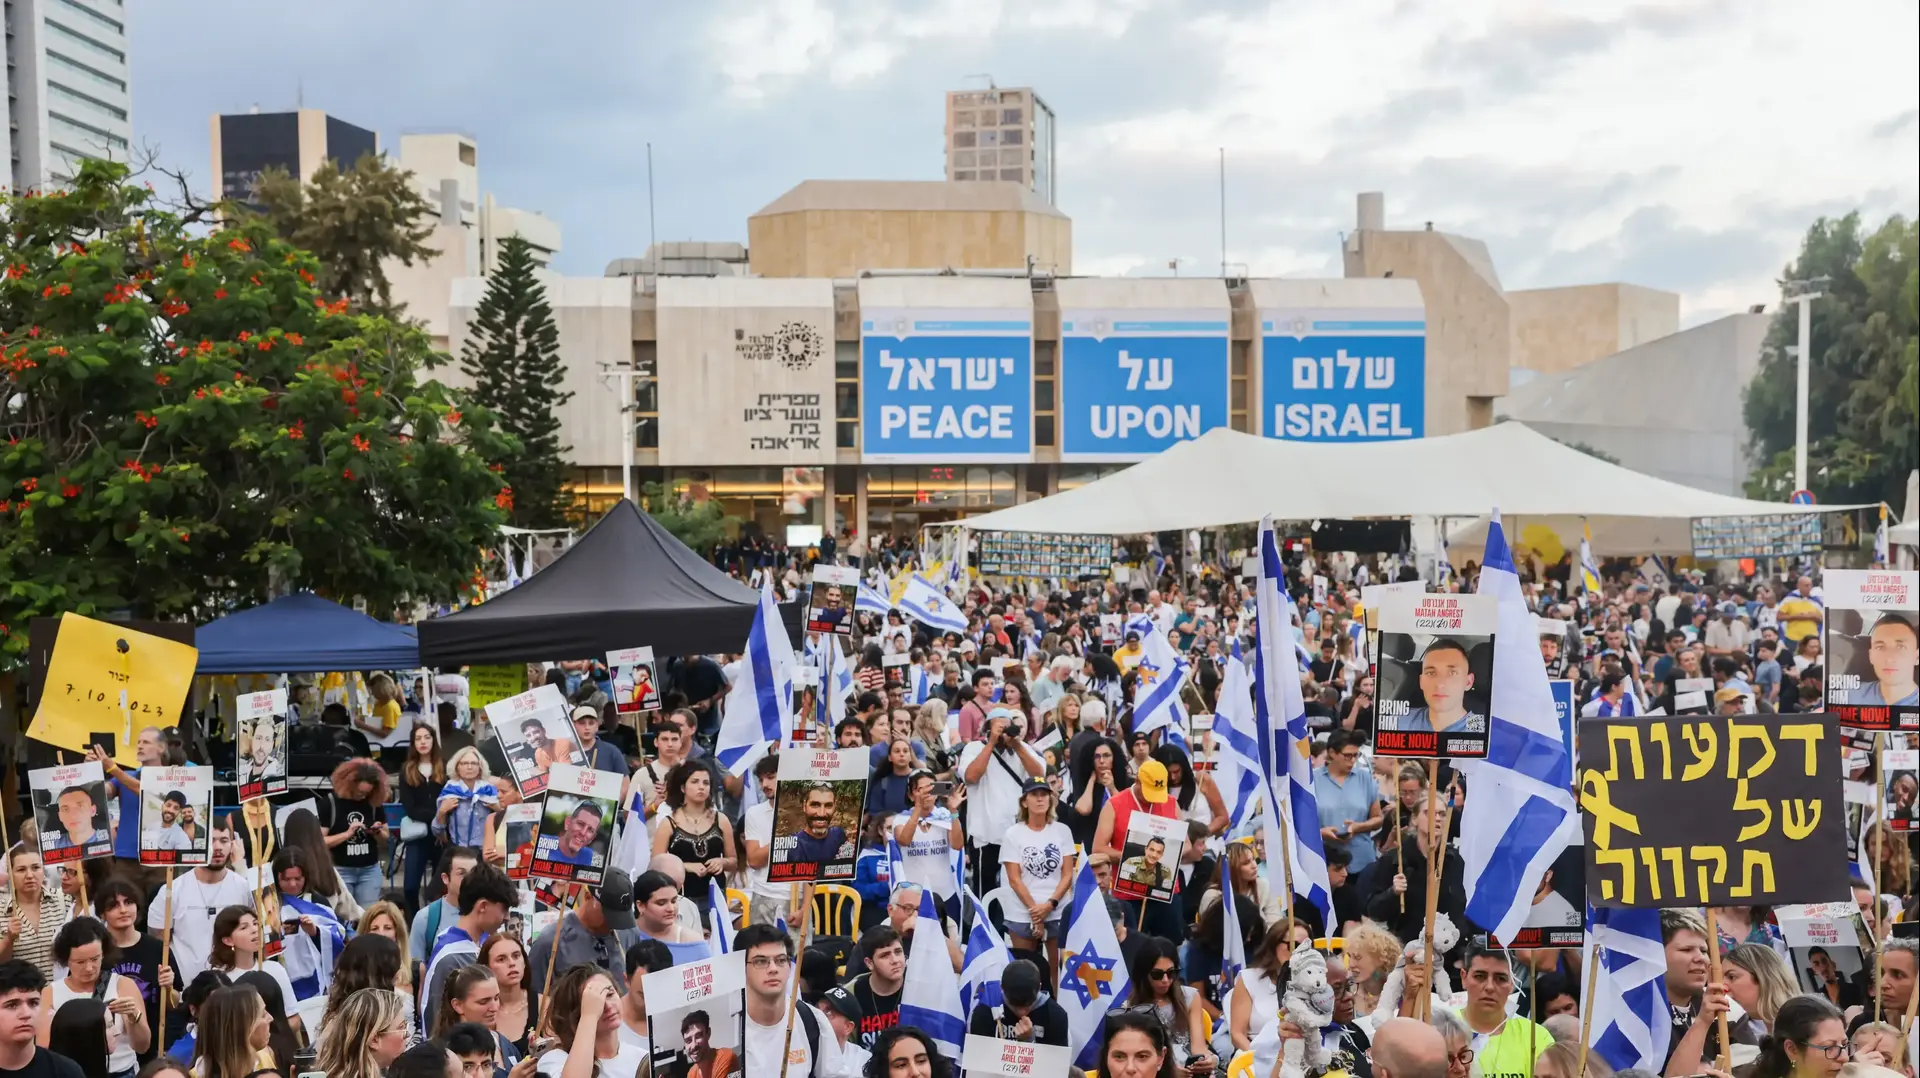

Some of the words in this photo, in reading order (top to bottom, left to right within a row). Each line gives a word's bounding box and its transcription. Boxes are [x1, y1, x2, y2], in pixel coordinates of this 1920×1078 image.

[879, 349, 1014, 390] ישראל
[1118, 350, 1173, 391] על
[1292, 349, 1395, 390] שלום
[757, 394, 820, 406] ספריית
[881, 404, 1013, 439] PEACE
[1090, 404, 1201, 439] UPON
[1274, 403, 1412, 437] ISRAEL
[789, 423, 820, 435] בית
[750, 436, 820, 450] אריאלה
[1415, 608, 1436, 618] MATAN
[1437, 608, 1464, 618] ANGREST
[1829, 674, 1861, 690] BRING
[65, 683, 164, 717] 7.10.023
[1828, 690, 1849, 705] HIM
[1379, 699, 1410, 716] BRING
[1860, 706, 1890, 723] NOW!
[1378, 715, 1398, 731] HIM
[1377, 732, 1406, 748] HOME
[1408, 732, 1438, 749] NOW!
[1603, 718, 1824, 782] דמעות
[826, 760, 840, 768] ADAR
[1732, 777, 1822, 842] של
[346, 843, 369, 856] NOW
[537, 837, 559, 850] BRING
[773, 836, 798, 850] BRING
[535, 848, 549, 860] HIM
[772, 849, 788, 863] HIM
[907, 848, 928, 857] HOME
[532, 860, 552, 873] HOME
[553, 862, 574, 876] NOW!
[771, 863, 794, 877] HOME
[794, 862, 818, 875] NOW!
[1594, 845, 1777, 905] תקווה
[695, 964, 712, 976] אריאל
[683, 980, 697, 991] ARIEL
[697, 974, 713, 986] CUNIO
[686, 989, 702, 1002] (27)
[1017, 1046, 1035, 1056] אריאל
[1001, 1054, 1016, 1063] ARIEL
[1017, 1055, 1034, 1065] CUNIO
